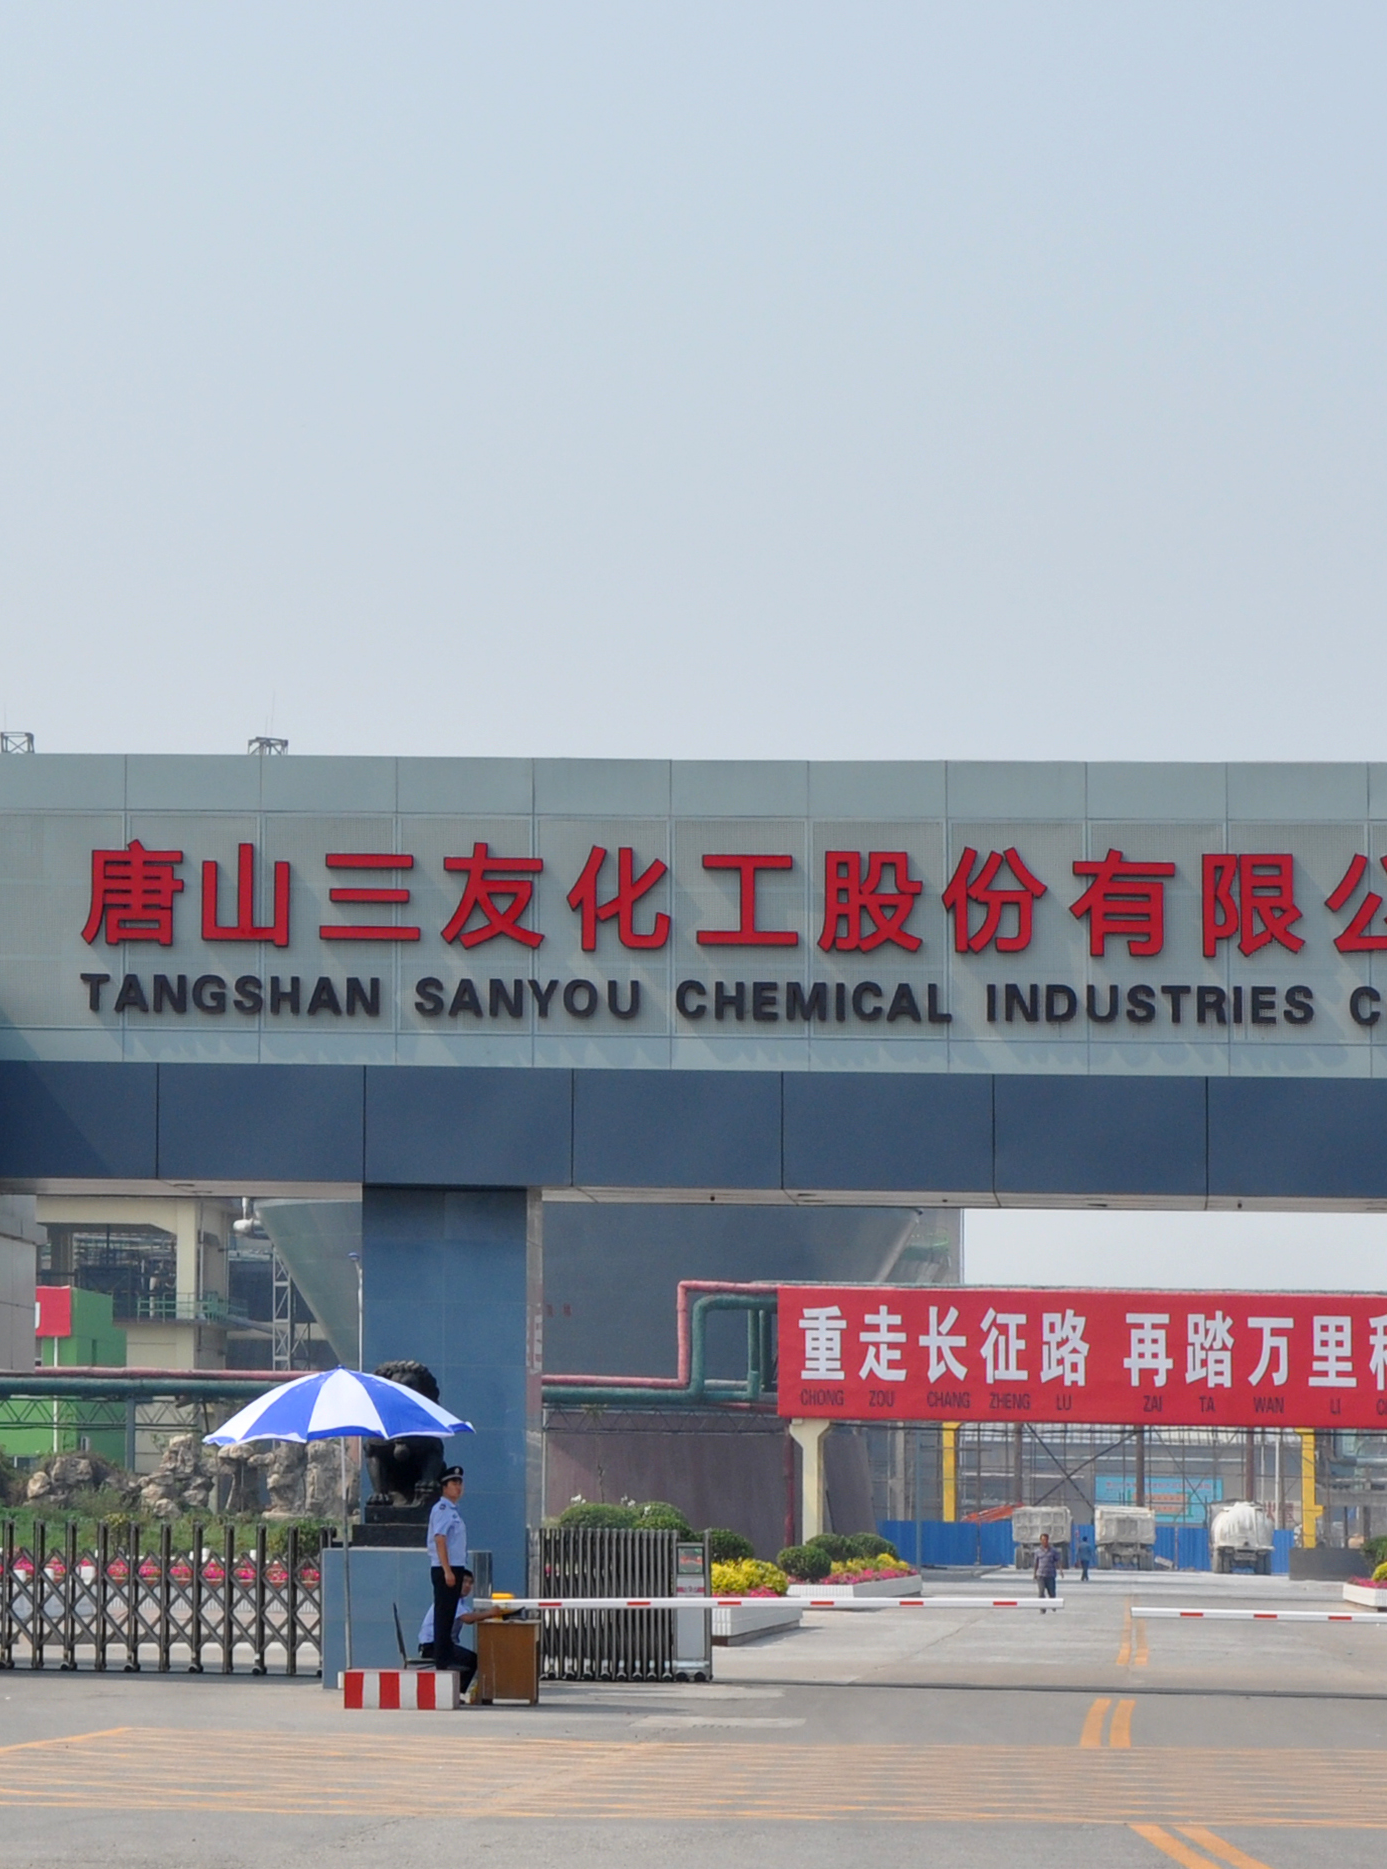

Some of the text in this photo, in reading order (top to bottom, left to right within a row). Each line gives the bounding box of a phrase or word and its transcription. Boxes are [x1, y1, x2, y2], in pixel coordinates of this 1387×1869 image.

[80, 972, 381, 1018] TANGSHAN
[414, 976, 641, 1021] SANYOU
[675, 979, 953, 1025] CHEMICAL
[986, 982, 1315, 1027] INDUSTRIES
[798, 1304, 1090, 1387] 重走长征路
[800, 1389, 844, 1407] CHONG
[868, 1390, 895, 1408] ZOU
[926, 1391, 971, 1409] CHANG
[989, 1392, 1032, 1411] ZHENG
[1056, 1394, 1073, 1411] LU
[1143, 1395, 1163, 1413] ZAI
[1199, 1396, 1216, 1413] TA
[1253, 1396, 1285, 1414] WAN
[1330, 1398, 1341, 1415] LI
